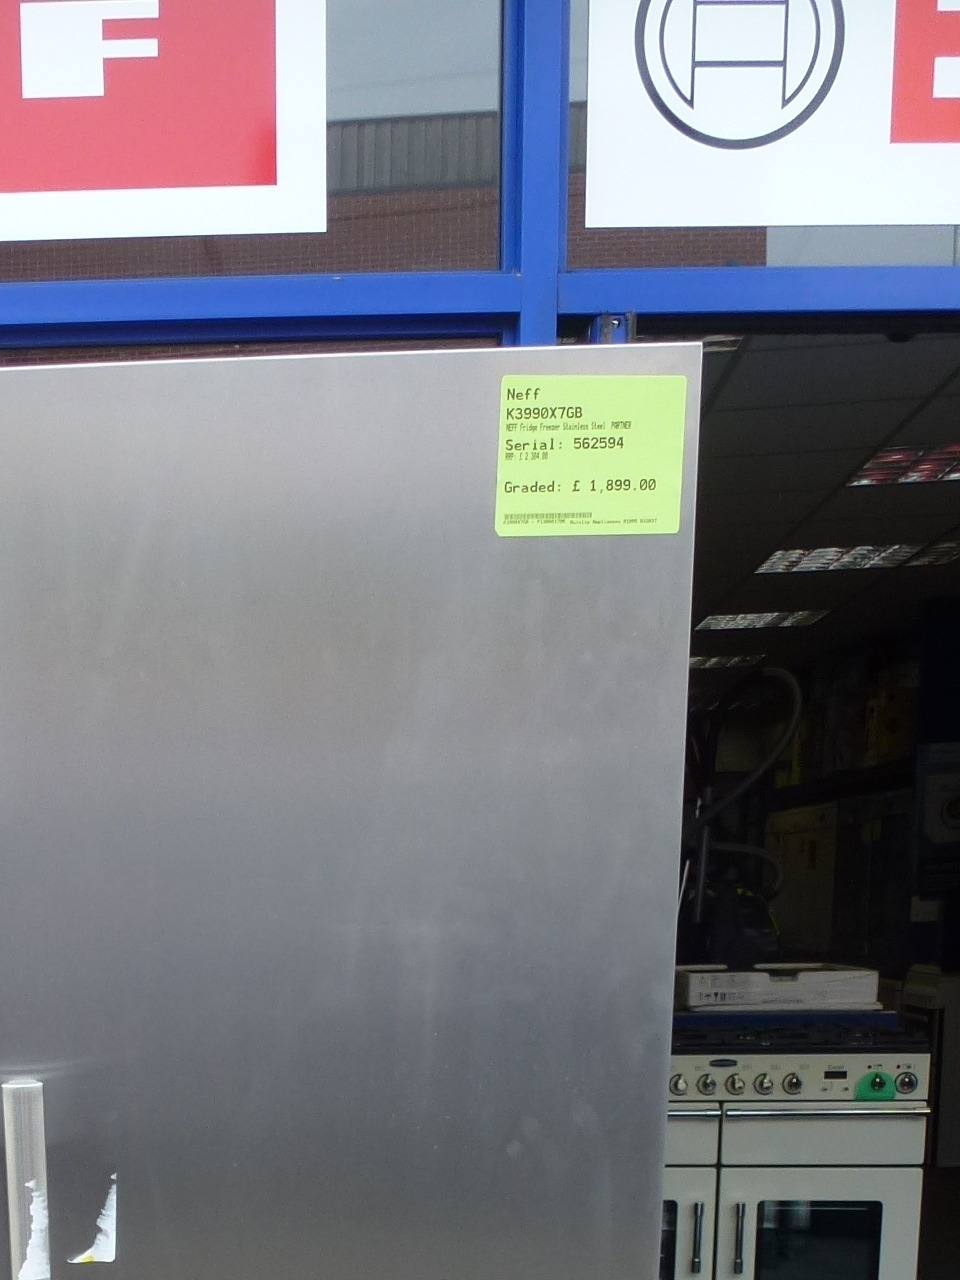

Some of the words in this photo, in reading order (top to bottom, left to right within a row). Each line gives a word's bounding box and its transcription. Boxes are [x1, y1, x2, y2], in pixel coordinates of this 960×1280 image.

[506, 387, 541, 401] Neff
[506, 406, 583, 420] K3990X7GB
[563, 422, 589, 431] Stainless
[591, 421, 606, 430] Steel
[505, 437, 563, 451] Serial:
[573, 436, 624, 450] 562594
[504, 480, 562, 494] Graded:
[572, 480, 581, 492] £
[590, 478, 657, 494] 1,899.00
